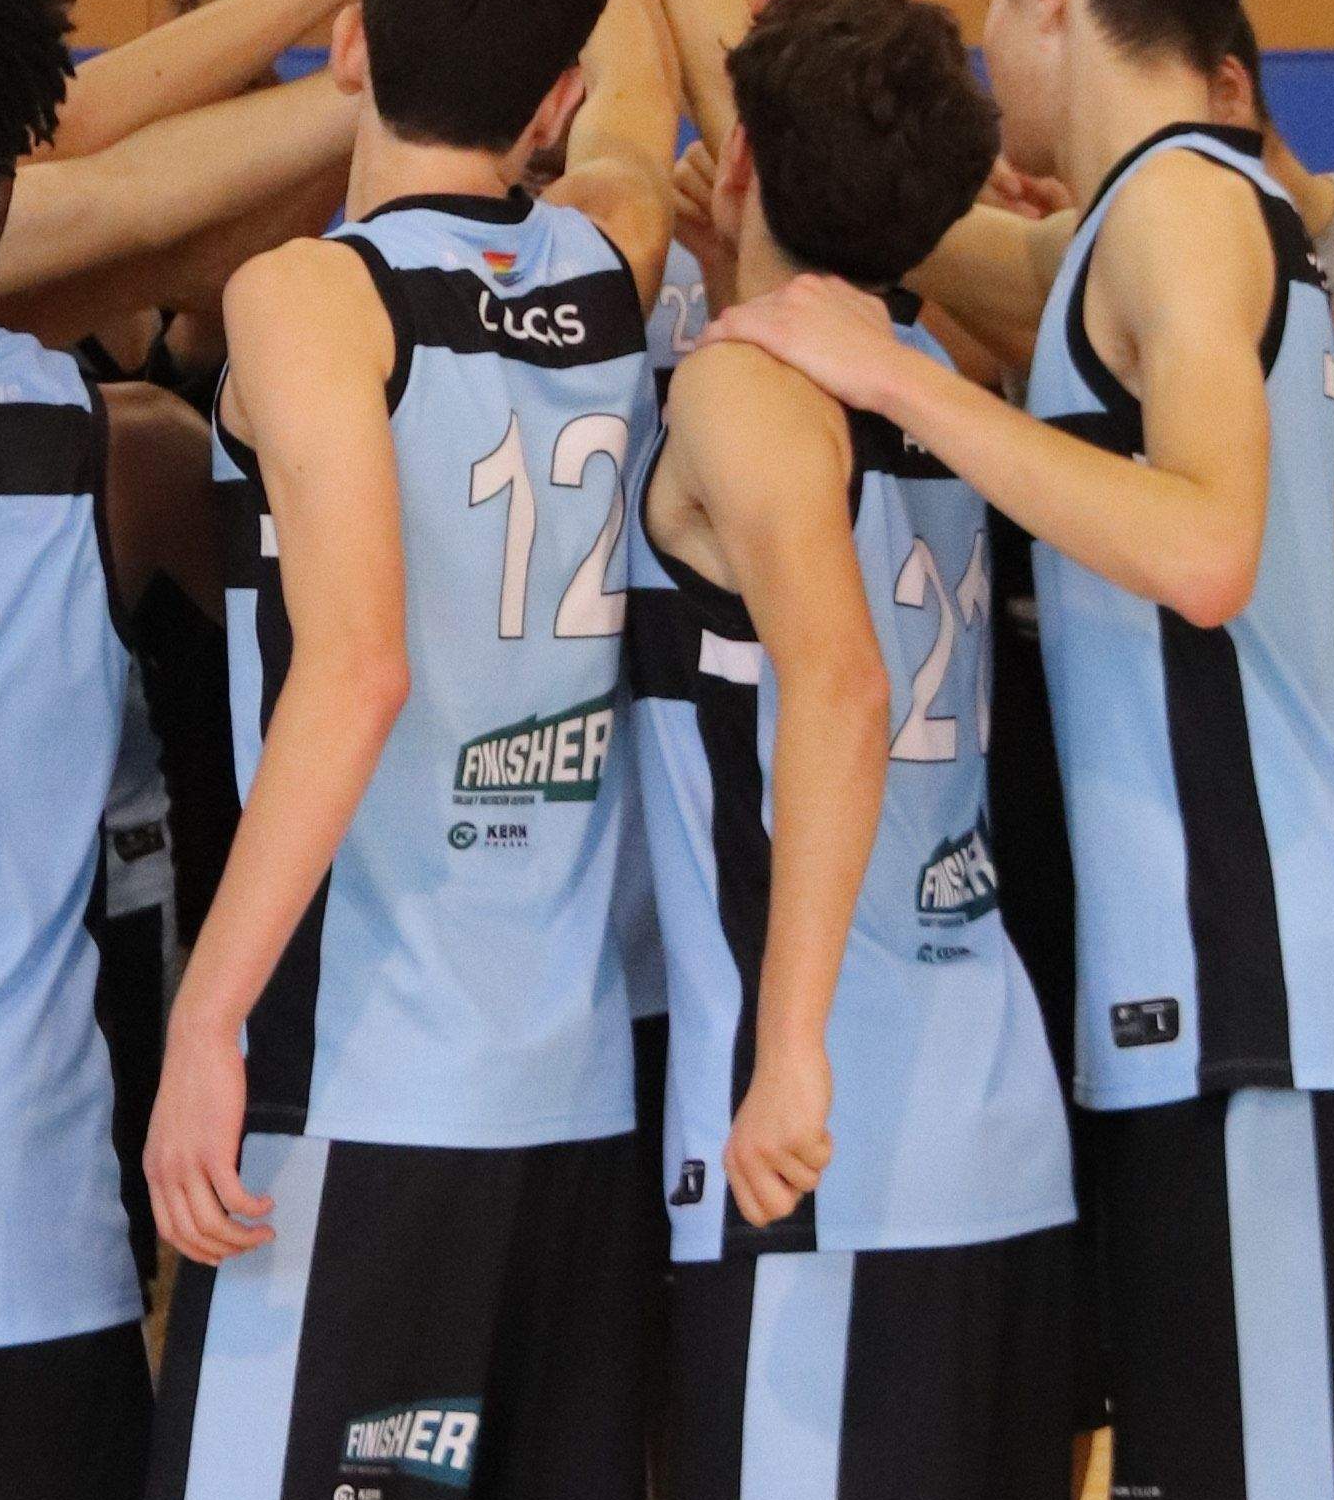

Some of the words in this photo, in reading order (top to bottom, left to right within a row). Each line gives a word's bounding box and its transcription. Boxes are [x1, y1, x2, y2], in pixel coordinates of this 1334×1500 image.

[469, 408, 630, 640] 12
[462, 708, 615, 788] FINISHER
[347, 1409, 480, 1470] FINISHER
